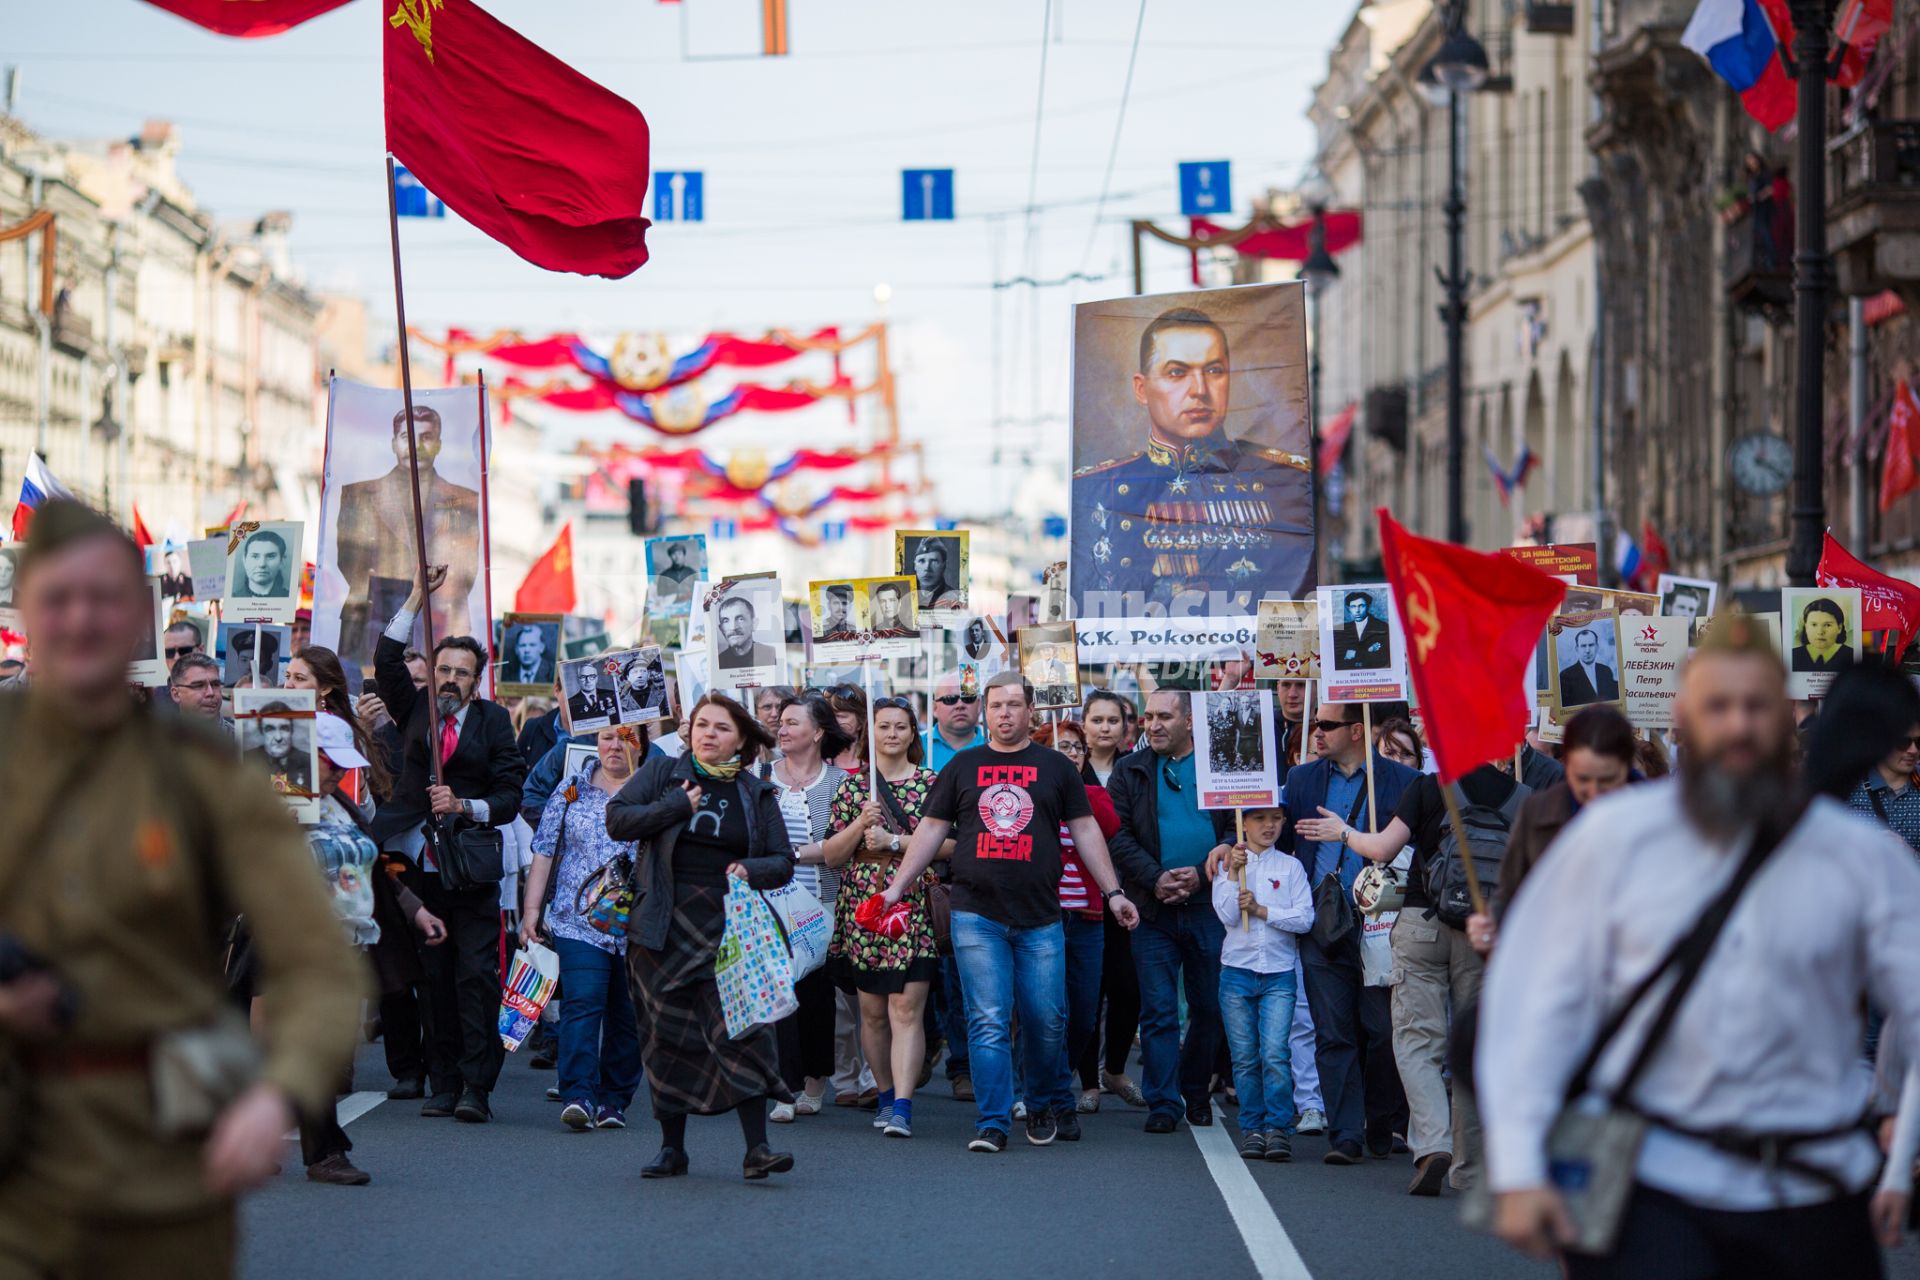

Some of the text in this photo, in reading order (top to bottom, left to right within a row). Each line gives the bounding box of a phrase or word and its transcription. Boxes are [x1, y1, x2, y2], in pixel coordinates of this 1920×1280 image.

[1521, 549, 1555, 559] ЗА НАШУ
[1534, 556, 1581, 566] СОВЕТСКУЮ
[1558, 563, 1592, 572] РОДИНУ!
[1864, 595, 1882, 612] 79
[1076, 629, 1118, 646] К.К.
[1624, 659, 1675, 671] ЛЕБЁЗКИН
[1636, 675, 1662, 686] Петр
[976, 765, 1038, 788] СССР
[975, 832, 1033, 862] USSR
[796, 910, 824, 928] Визитки
[503, 988, 537, 1014] АДУГИ
